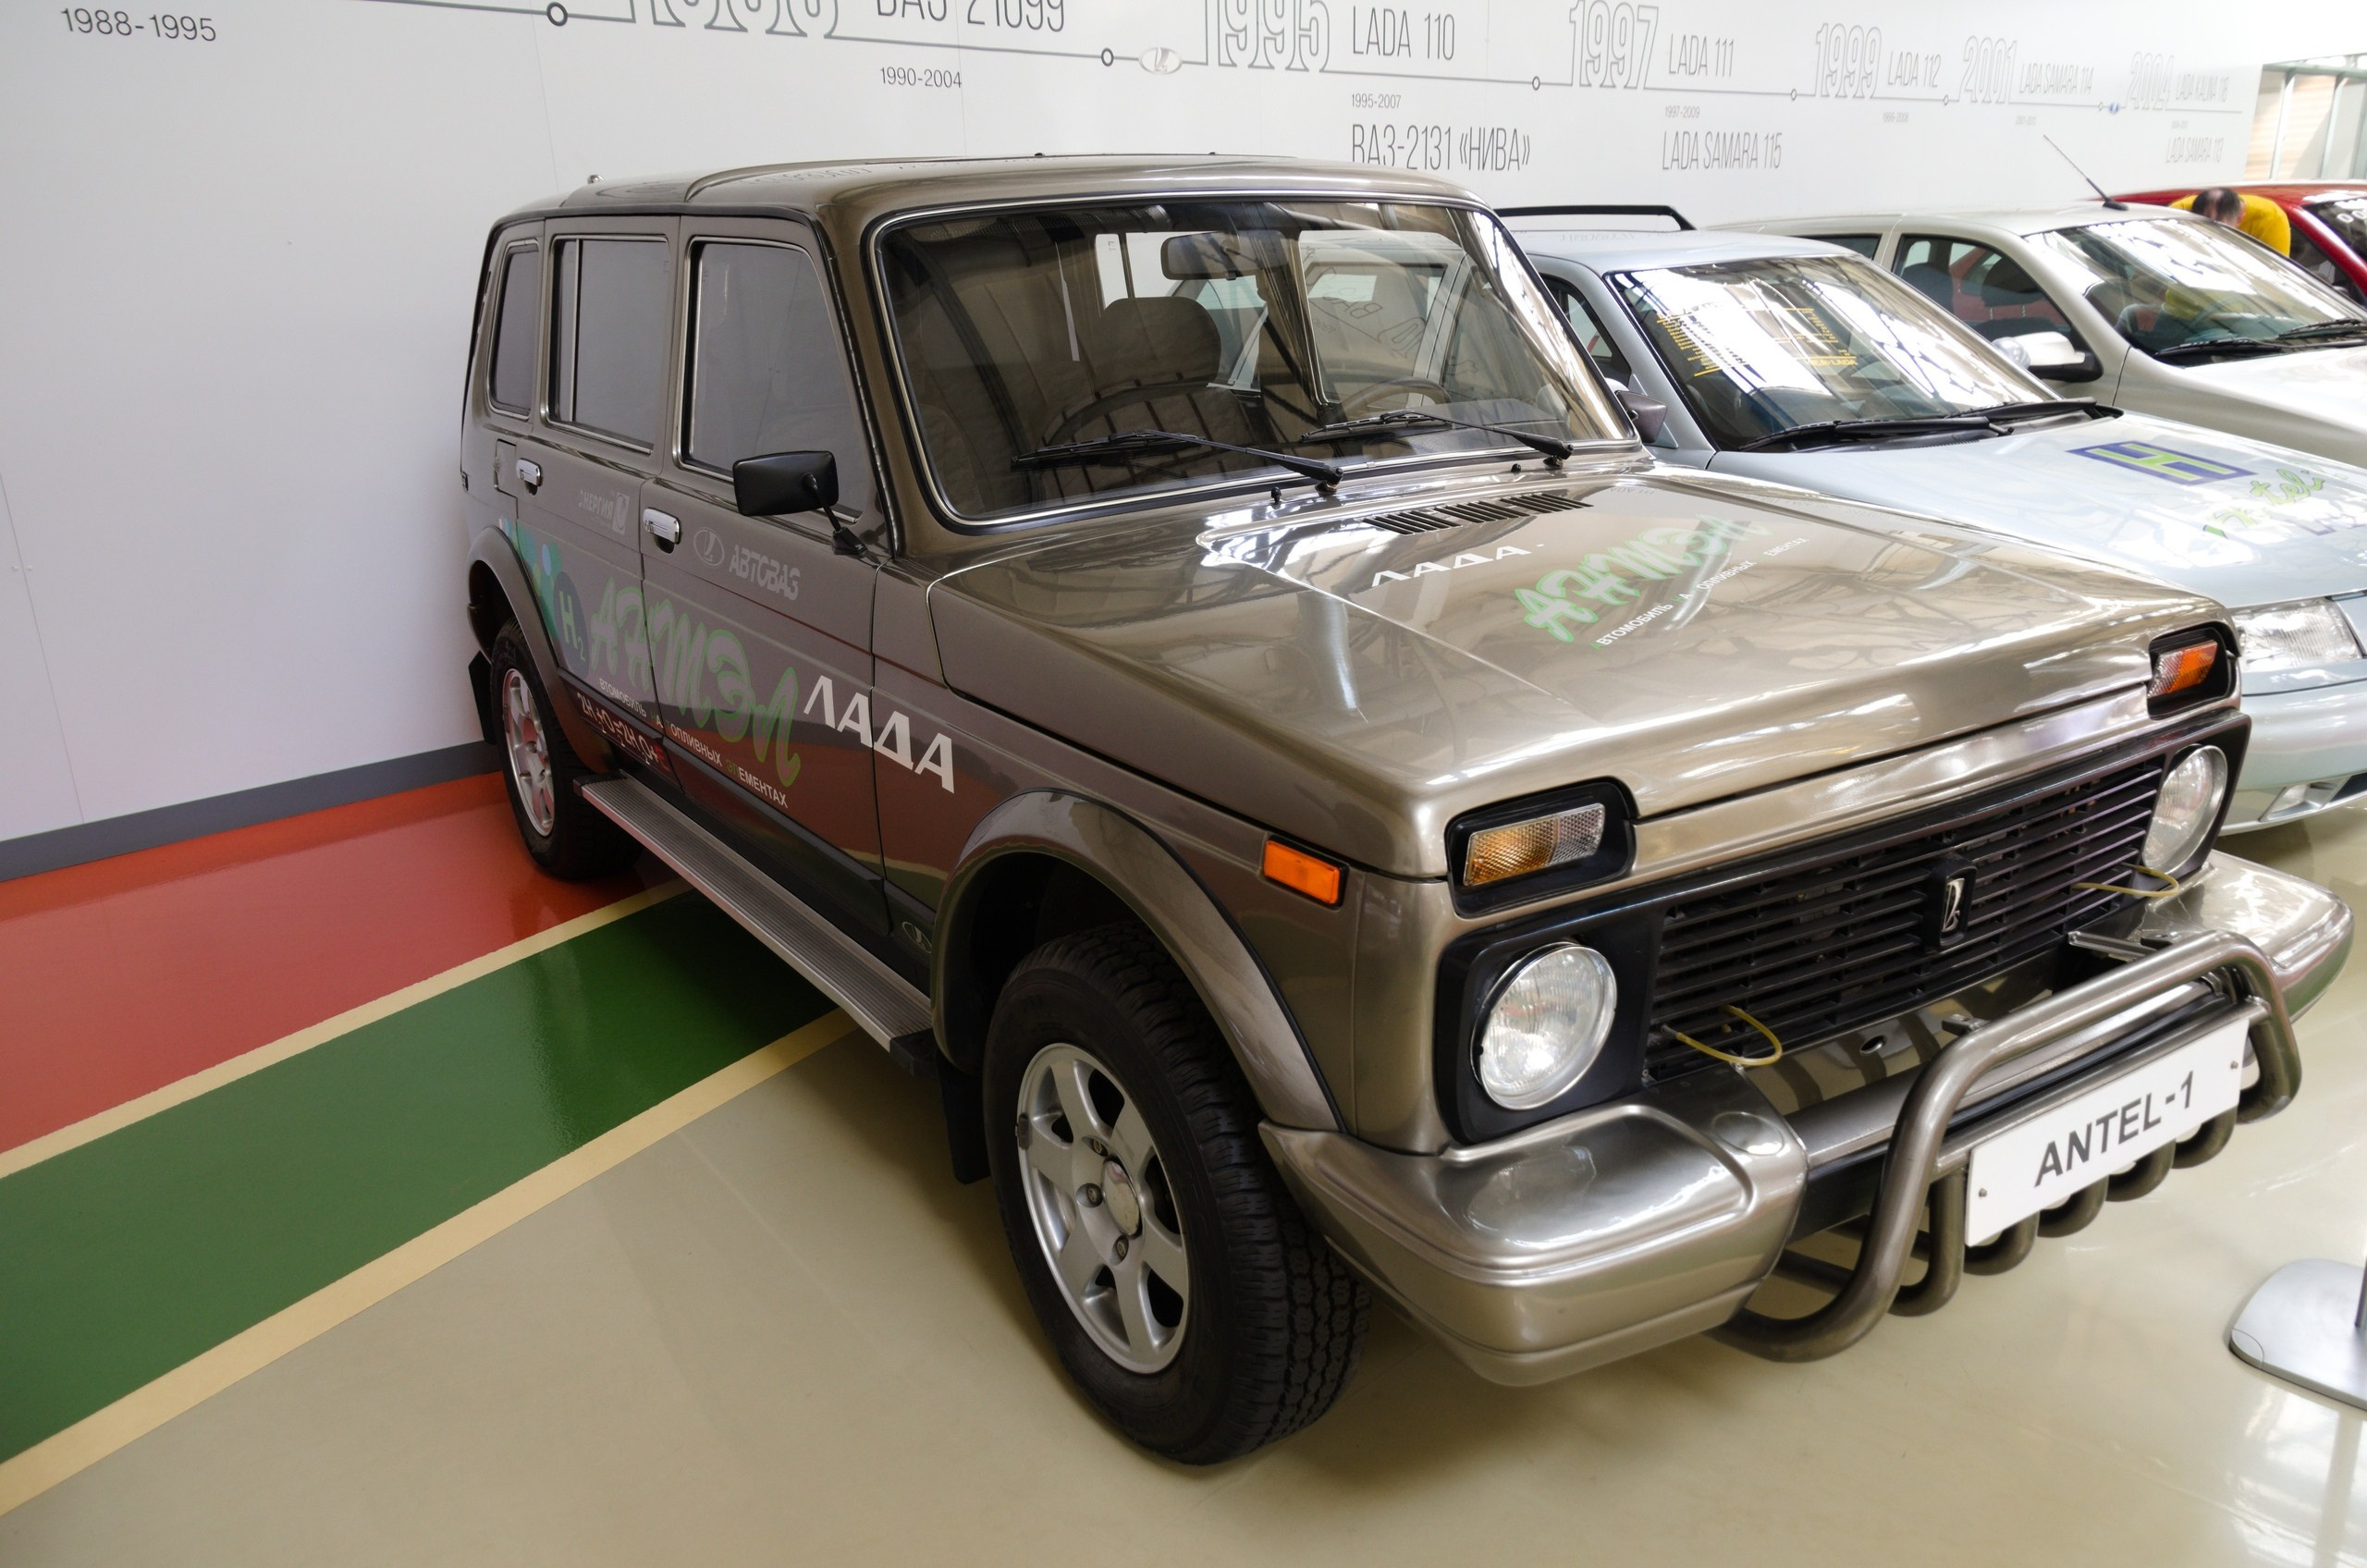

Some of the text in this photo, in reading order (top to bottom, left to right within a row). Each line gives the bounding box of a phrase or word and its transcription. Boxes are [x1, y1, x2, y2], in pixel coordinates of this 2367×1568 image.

[61, 7, 216, 42] 1988-1995
[1353, 6, 1454, 60] LADA 110
[1569, 0, 1659, 90] 1997
[1668, 33, 1734, 78] LADA 111
[1814, 22, 1882, 99] 1999
[1887, 51, 1942, 89] LADA 112
[1959, 35, 2017, 104] 2001
[880, 67, 962, 89] 1990-2004
[2019, 62, 2043, 94] LADA
[1352, 93, 1401, 109] 1995-2007
[1662, 131, 1783, 170] LADA SAMARA 115
[729, 545, 801, 601] АВТОВАЗ
[599, 678, 647, 717] ВТОМОБИЛЬ
[2034, 1070, 2194, 1188] ANTEL-1
